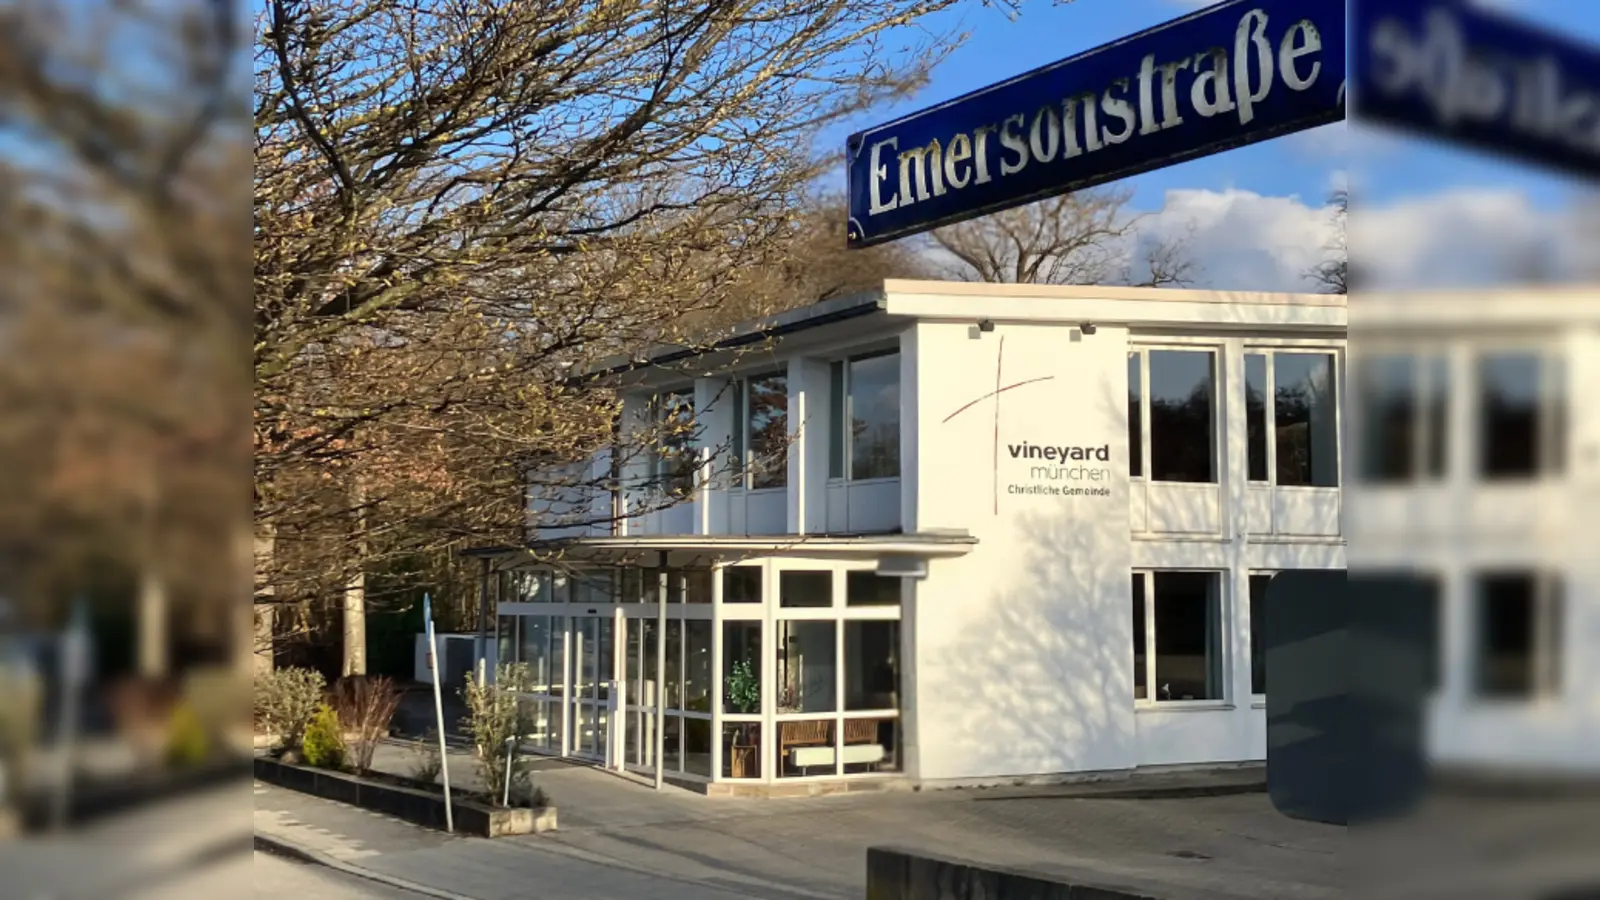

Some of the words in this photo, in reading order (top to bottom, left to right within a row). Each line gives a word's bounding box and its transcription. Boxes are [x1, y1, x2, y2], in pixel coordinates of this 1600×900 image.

[868, 8, 1322, 216] Emersonstraße
[1007, 441, 1109, 465] vineyard
[1030, 464, 1111, 481] münchen
[1007, 484, 1060, 496] Christliche
[1062, 486, 1111, 497] Gemeinde
